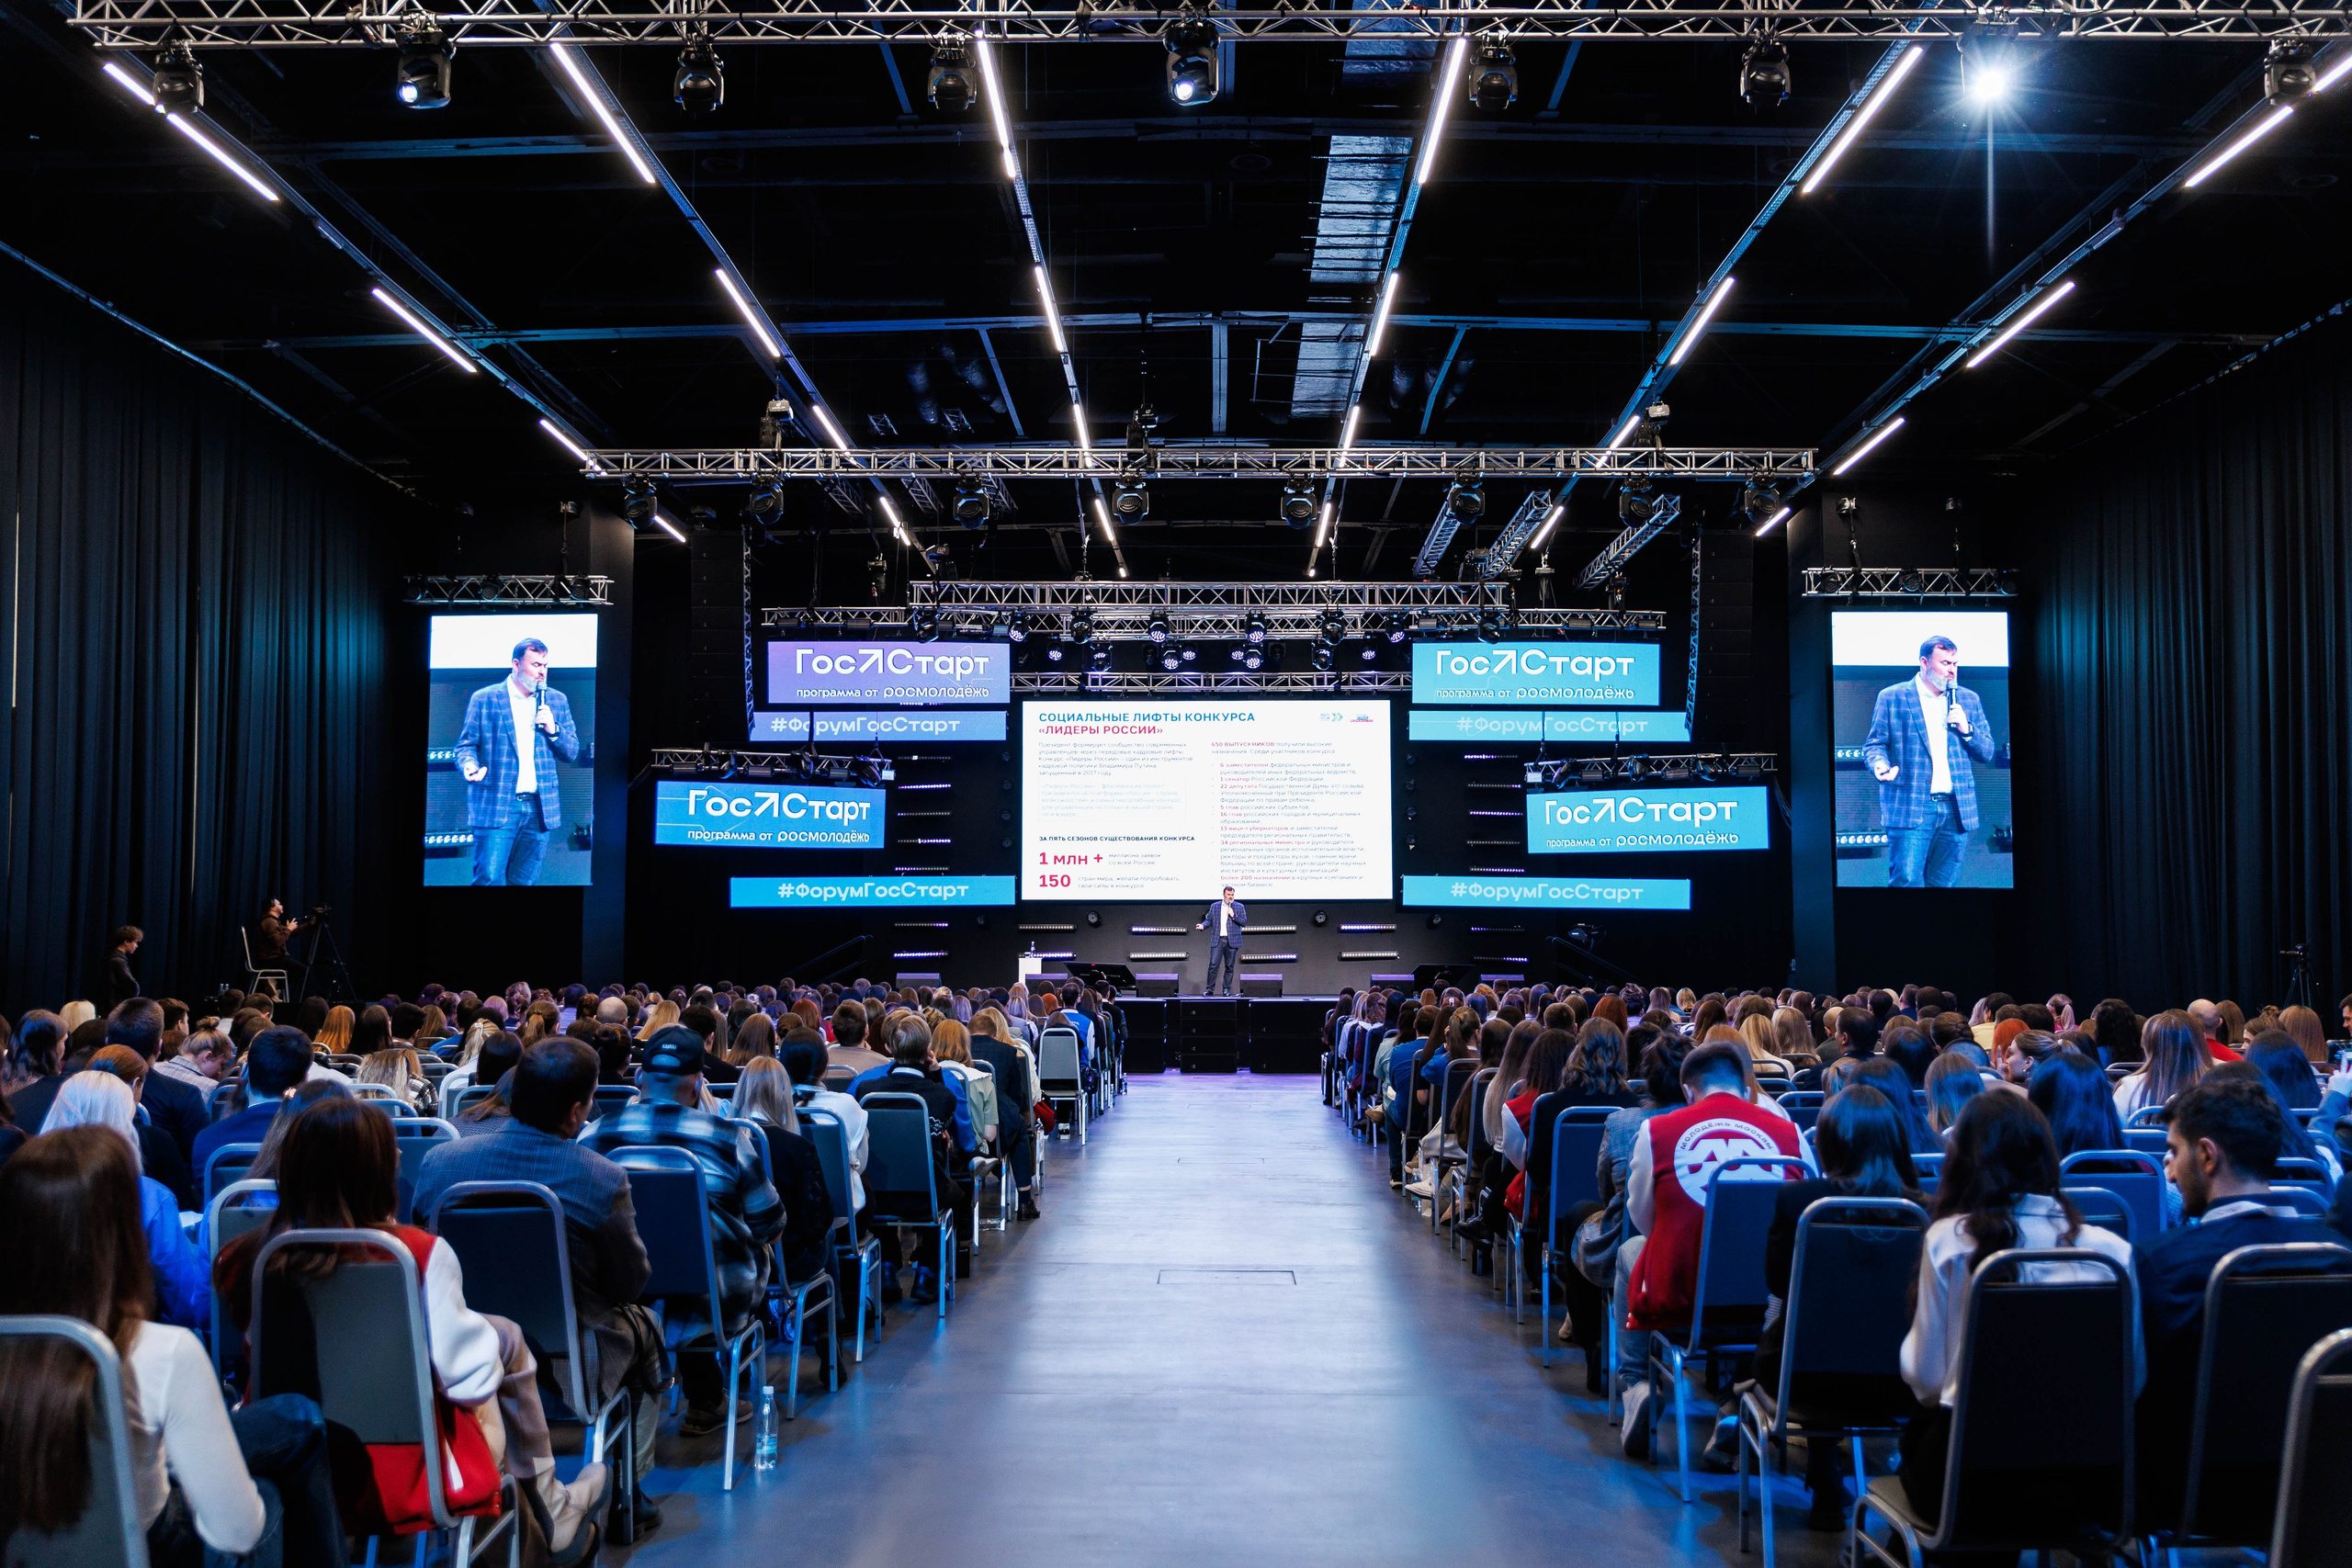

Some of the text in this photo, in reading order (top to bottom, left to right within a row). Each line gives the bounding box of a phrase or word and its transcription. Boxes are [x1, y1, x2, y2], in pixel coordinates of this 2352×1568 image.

[797, 689, 861, 698] программа
[884, 685, 989, 698] росмолодёжь
[1437, 686, 1634, 699] программа от росмолодёжь
[1039, 713, 1255, 723] СОЦИАЛЬНЫЕ ЛИФТЫ КОНКУРСА
[771, 717, 960, 735] #ФорумГосСтарт
[1039, 726, 1163, 735] «ЛИДЕРЫ РОССИИ»
[1457, 716, 1647, 735] #ФорумГосСтарт
[688, 830, 755, 842] программа
[777, 829, 869, 843] росмолодёжь
[1546, 832, 1738, 848] программа от росмолодёжь
[1040, 852, 1047, 864] 1
[1054, 855, 1087, 864] млн
[1040, 874, 1070, 887] 150
[778, 882, 968, 900] #ФорумГосСтарт
[1451, 883, 1643, 902] #ФорумГосСтарт
[1680, 1122, 1773, 1150] МОЛОДЁЖЬ МОСКВЫ
